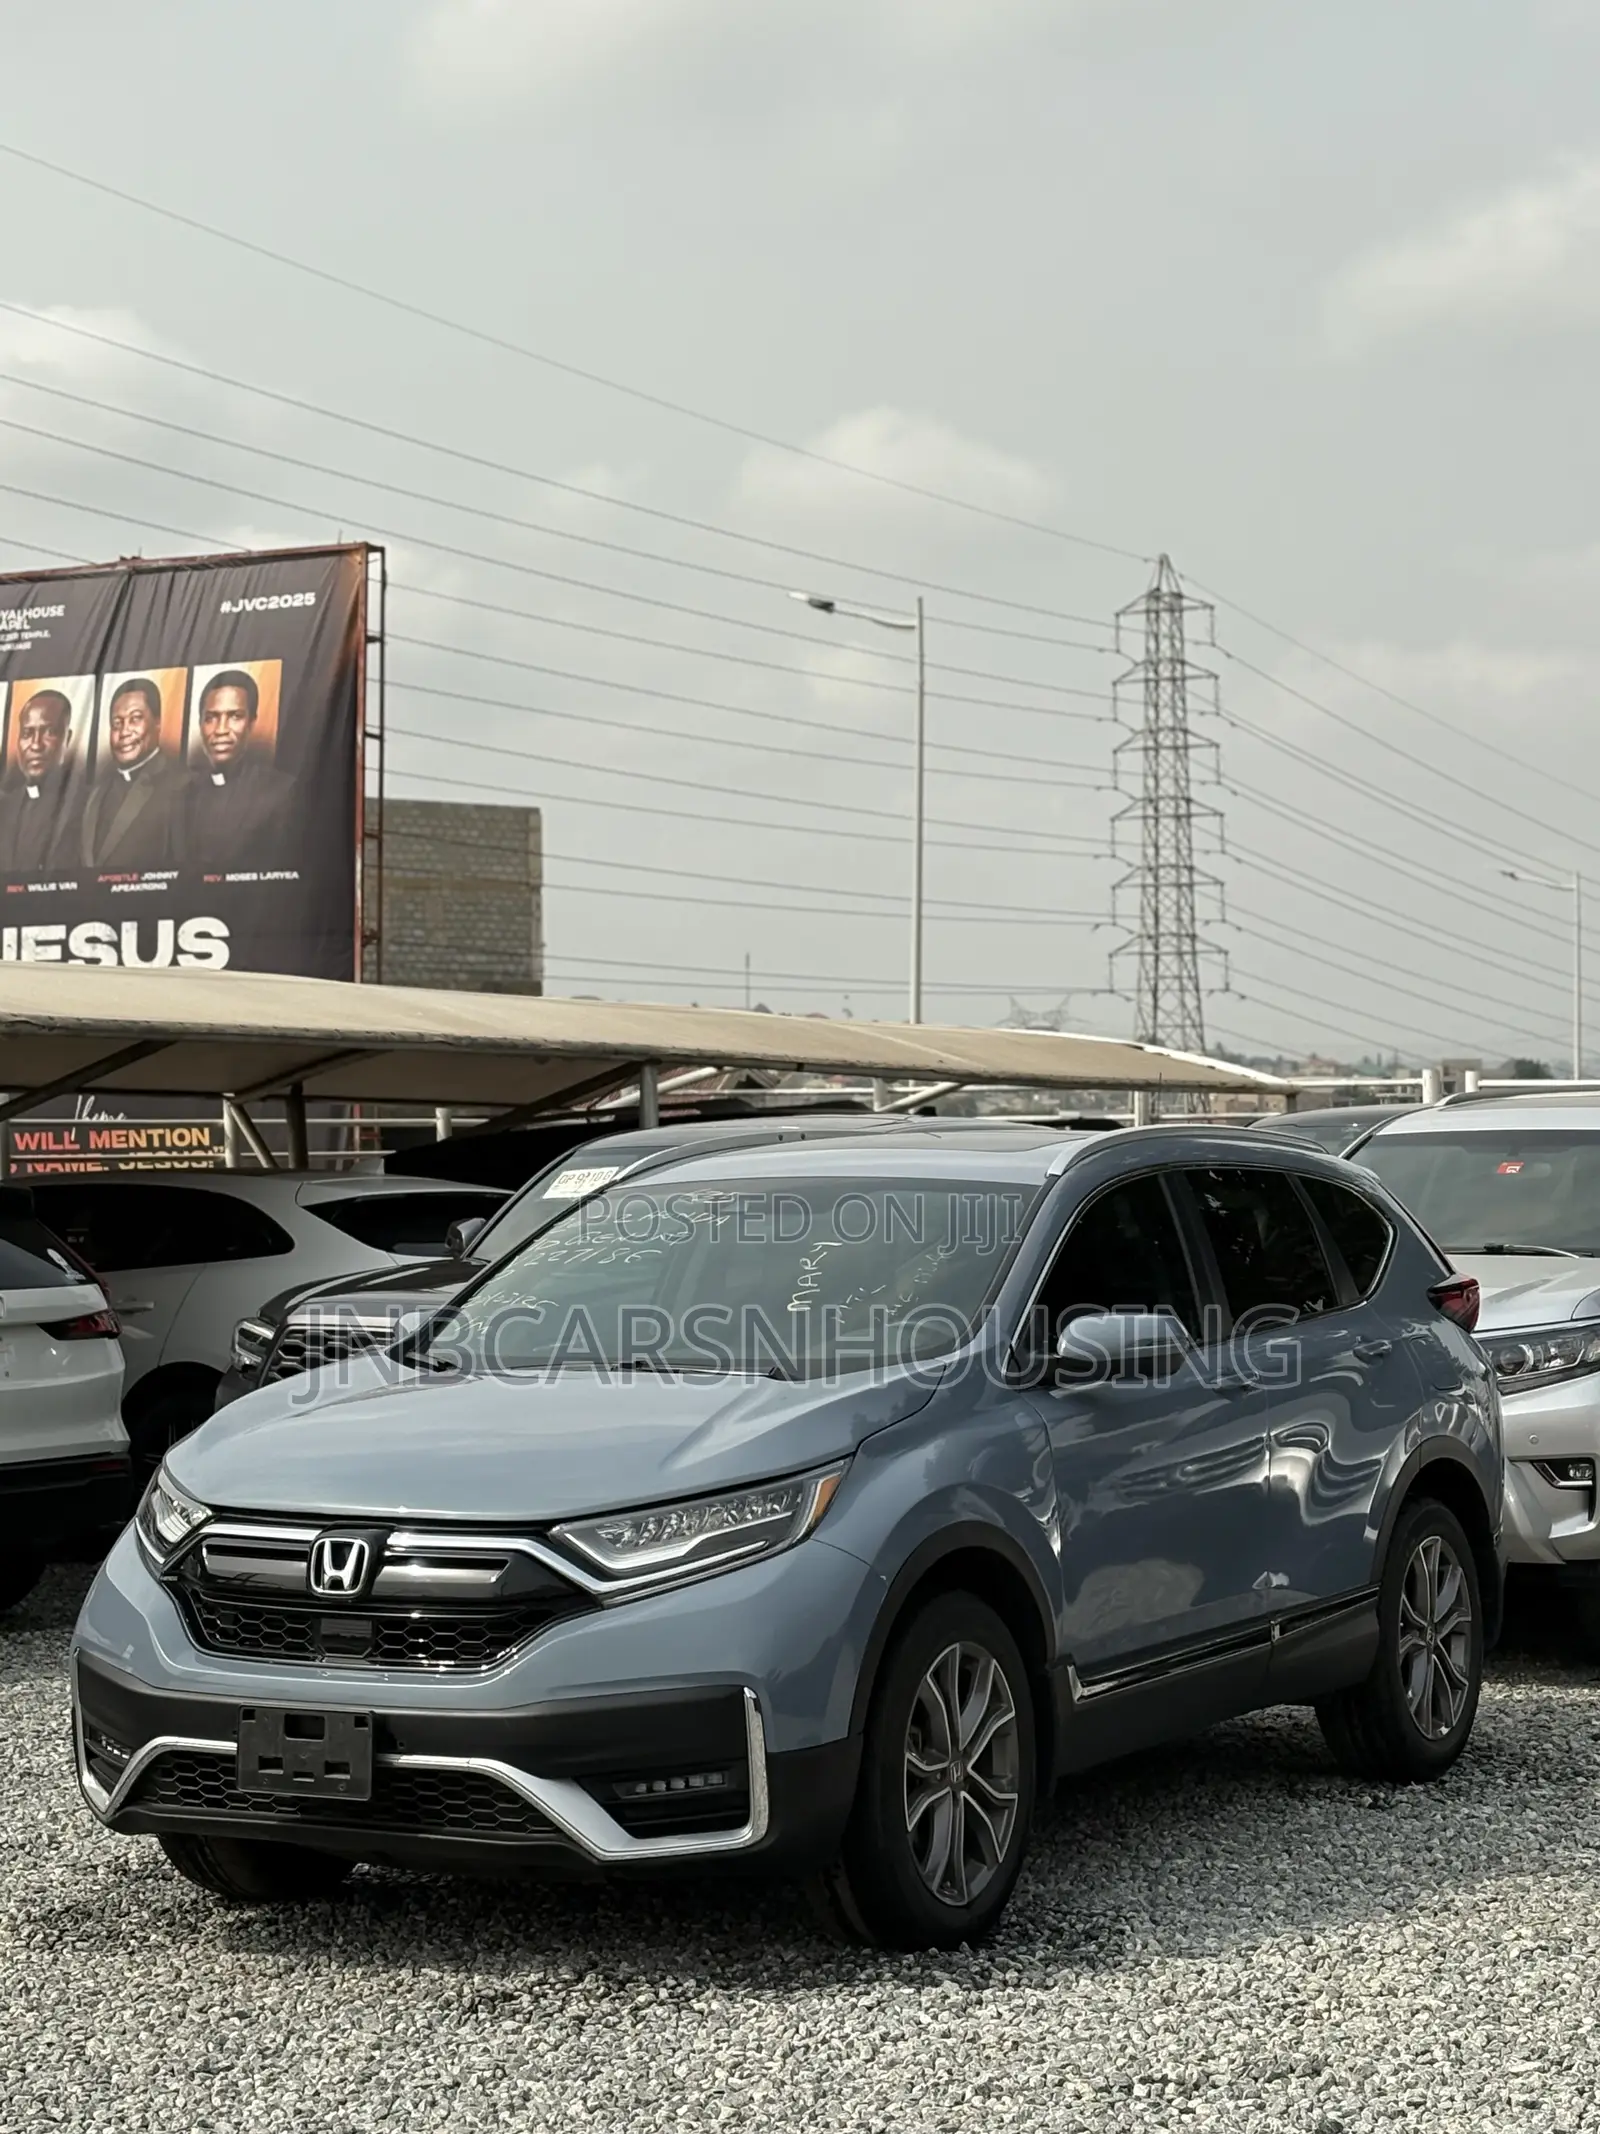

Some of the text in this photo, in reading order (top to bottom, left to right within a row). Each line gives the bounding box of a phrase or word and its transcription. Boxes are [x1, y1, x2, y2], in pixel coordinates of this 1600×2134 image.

[220, 592, 316, 613] #JVC2025
[0, 604, 65, 620] YALHOUSE
[97, 871, 179, 882] APOSTLE JOHNNY
[225, 872, 258, 882] MOSES
[259, 871, 299, 881] LARYEA
[14, 1127, 210, 1150] WILL MENTION
[786, 1241, 843, 1311] MARY
